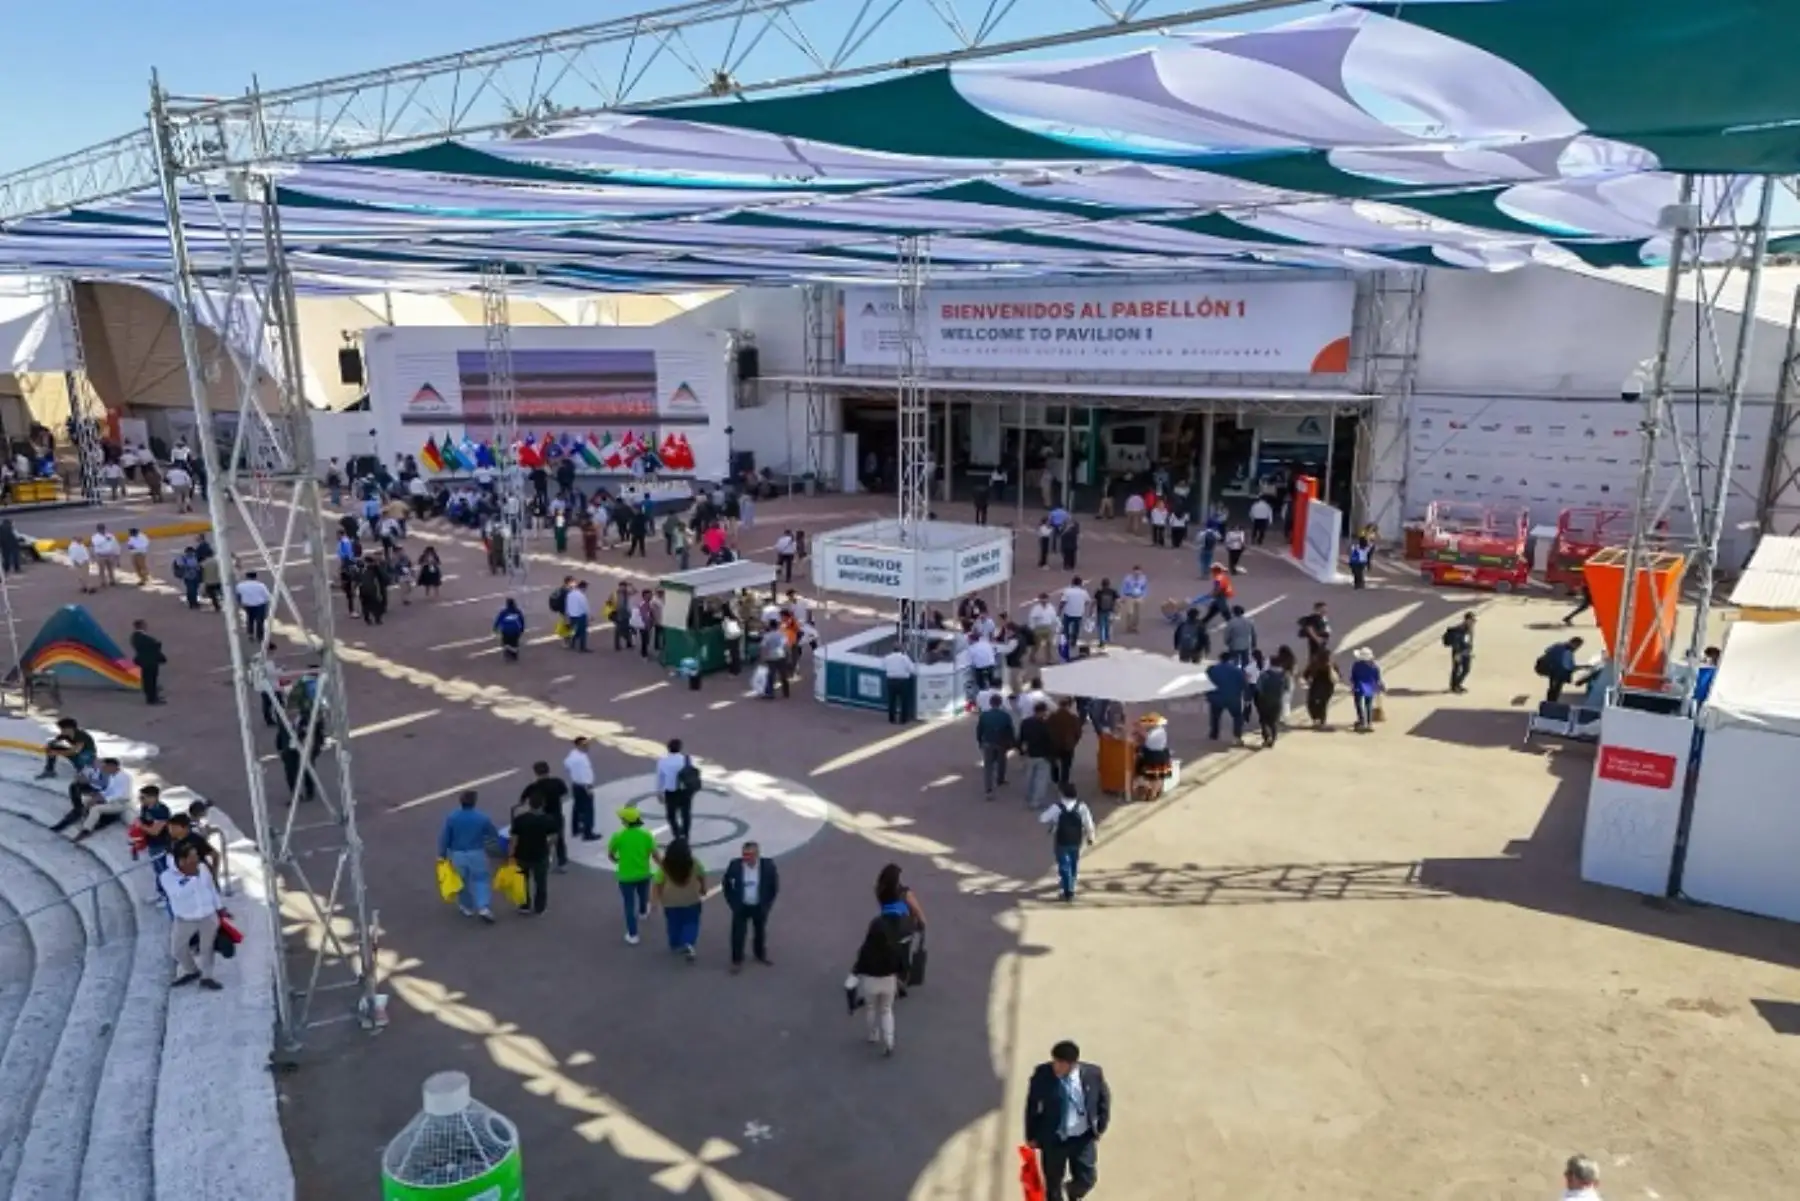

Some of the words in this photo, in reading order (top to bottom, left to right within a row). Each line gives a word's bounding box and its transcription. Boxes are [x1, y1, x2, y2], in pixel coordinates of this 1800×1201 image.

[941, 303, 1075, 320] BIENVENIDOS
[1080, 302, 1107, 318] AL
[1112, 297, 1231, 318] PABELLÓN
[1237, 300, 1246, 317] 1
[941, 328, 1025, 341] WELCOME
[1030, 328, 1051, 341] TO
[1056, 327, 1140, 341] PAVILION
[1146, 327, 1153, 340] 1
